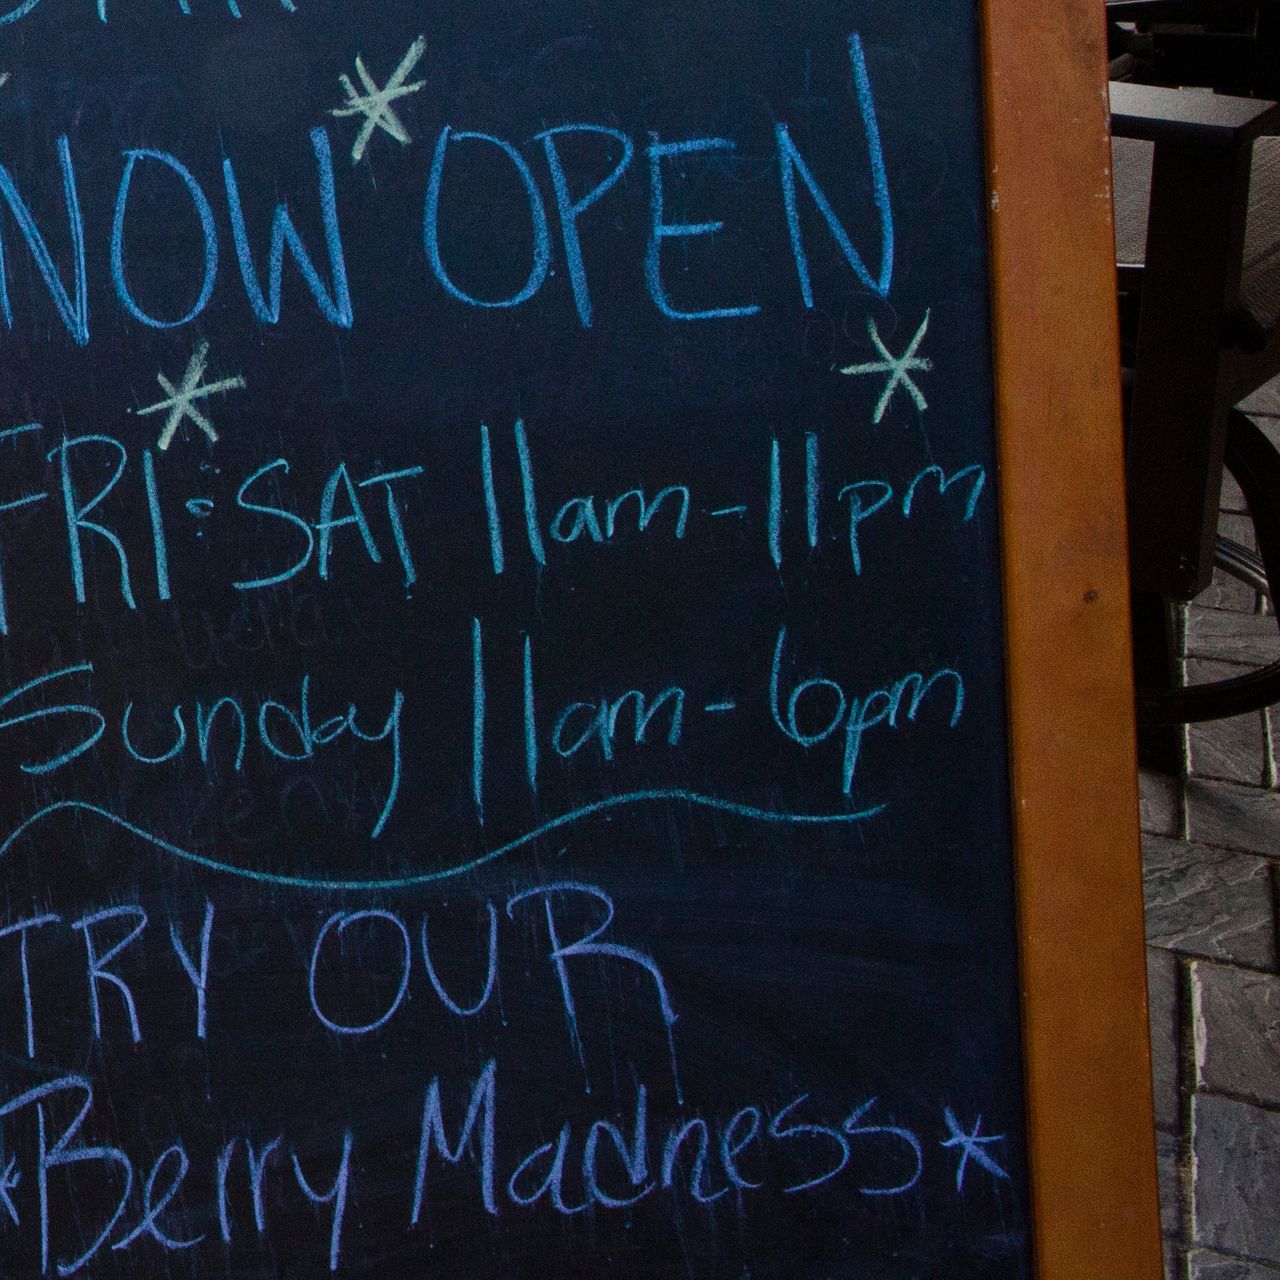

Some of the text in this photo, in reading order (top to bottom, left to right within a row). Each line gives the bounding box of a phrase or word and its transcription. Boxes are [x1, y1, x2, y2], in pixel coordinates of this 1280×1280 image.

[422, 34, 895, 327] OPEN
[309, 881, 682, 1055] OUR
[412, 1058, 924, 1224] Madness
